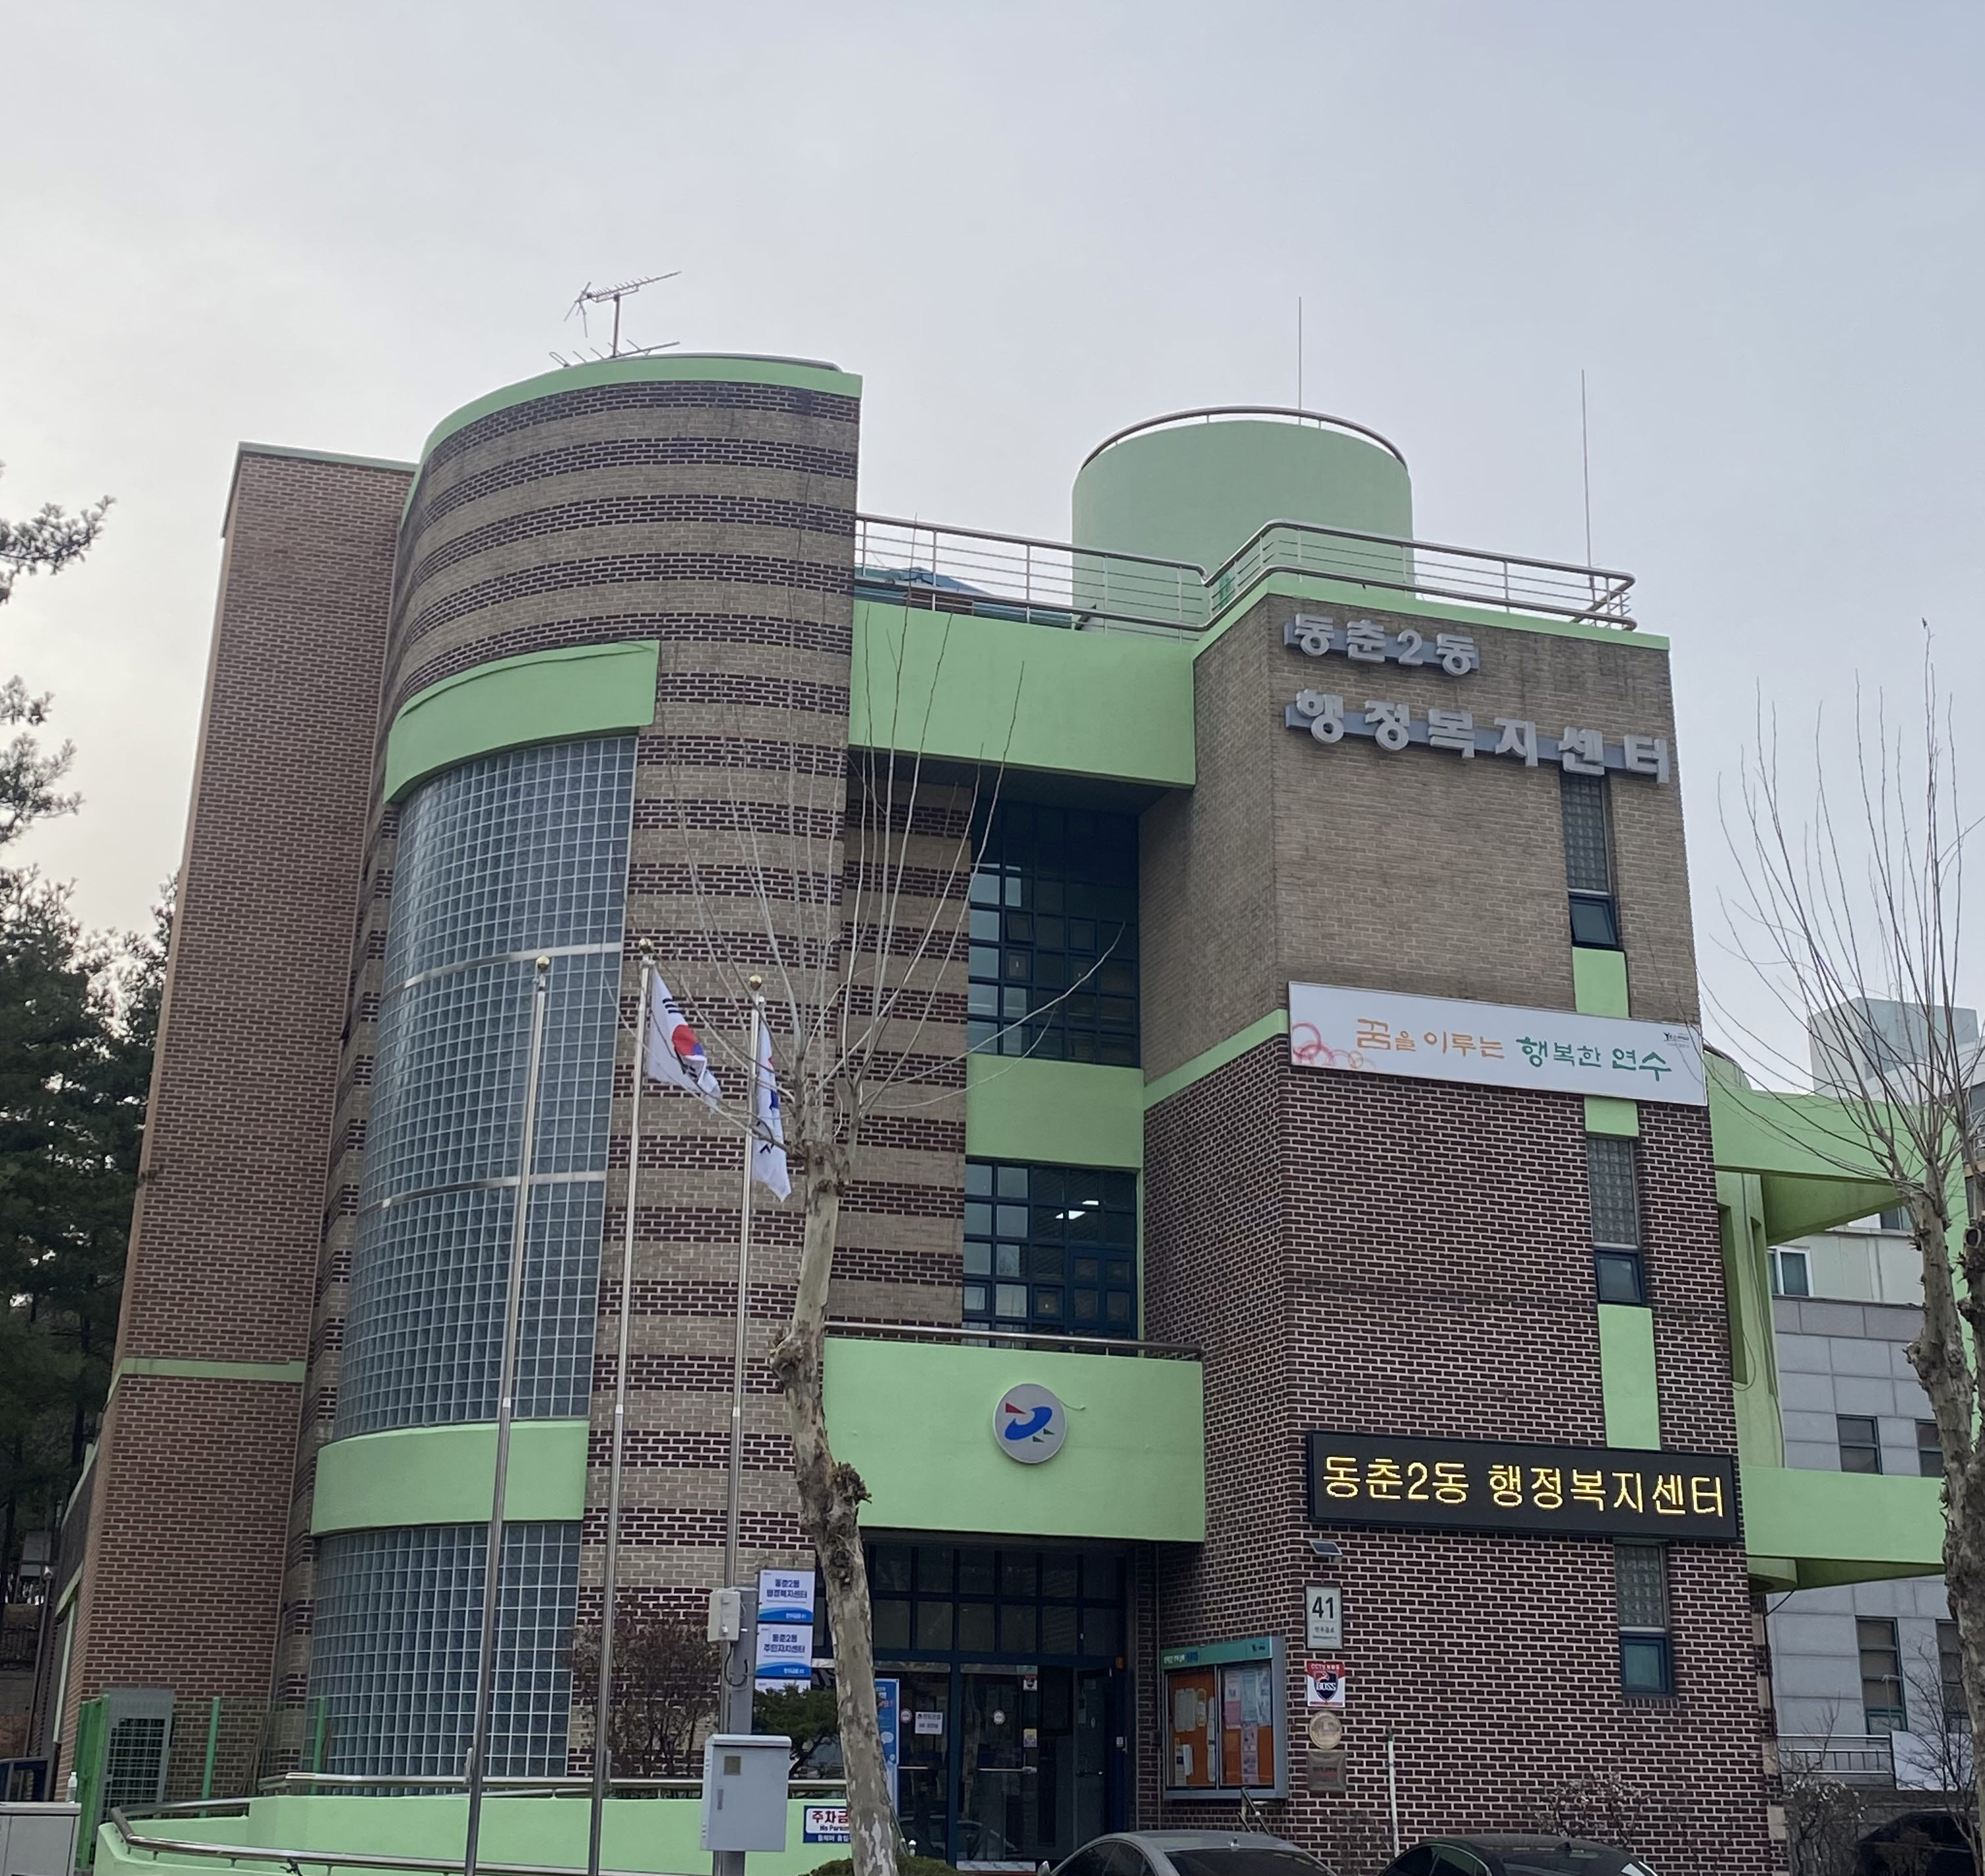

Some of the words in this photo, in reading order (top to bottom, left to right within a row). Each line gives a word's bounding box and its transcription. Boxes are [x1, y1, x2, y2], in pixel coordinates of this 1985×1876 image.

[1294, 613, 1475, 676] 동춘2동
[1296, 688, 1670, 784] 행정복지센터
[1356, 1018, 1416, 1052] 꿈을
[1423, 1031, 1505, 1058] 이루는
[1516, 1037, 1602, 1068] 행복한
[1611, 1048, 1672, 1081] 연수
[1322, 1455, 1470, 1504] 동춘2동
[1487, 1463, 1724, 1517] 행정복지센터
[1312, 1596, 1333, 1619] 41
[812, 1810, 849, 1823] 주차금
